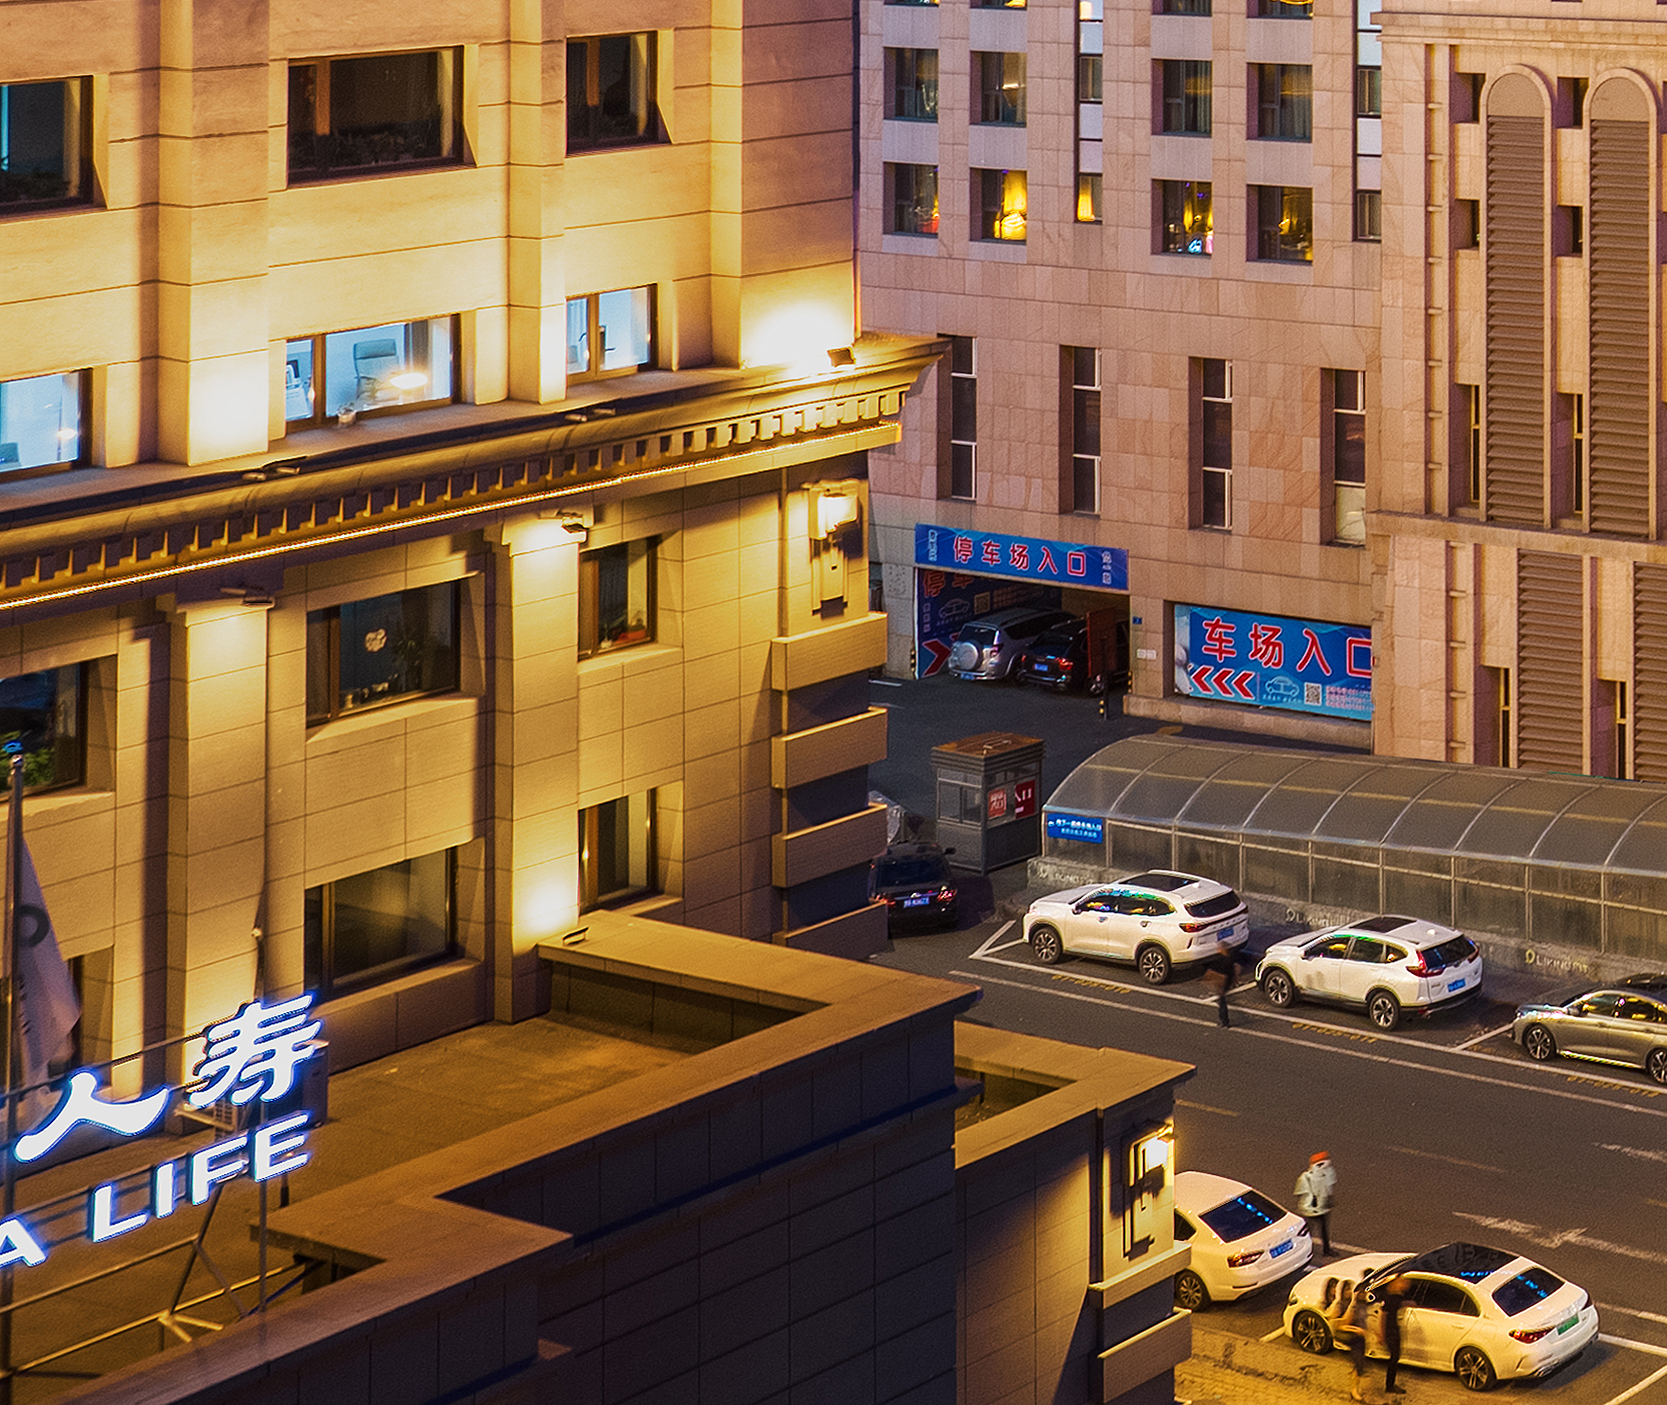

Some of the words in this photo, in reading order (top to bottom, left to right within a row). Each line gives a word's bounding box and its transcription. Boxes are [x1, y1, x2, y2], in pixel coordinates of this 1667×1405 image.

[953, 535, 1086, 576] 停车场入口
[1202, 617, 1372, 678] 车场入口
[14, 992, 323, 1162] 人寿
[91, 1112, 310, 1243] LIFE
